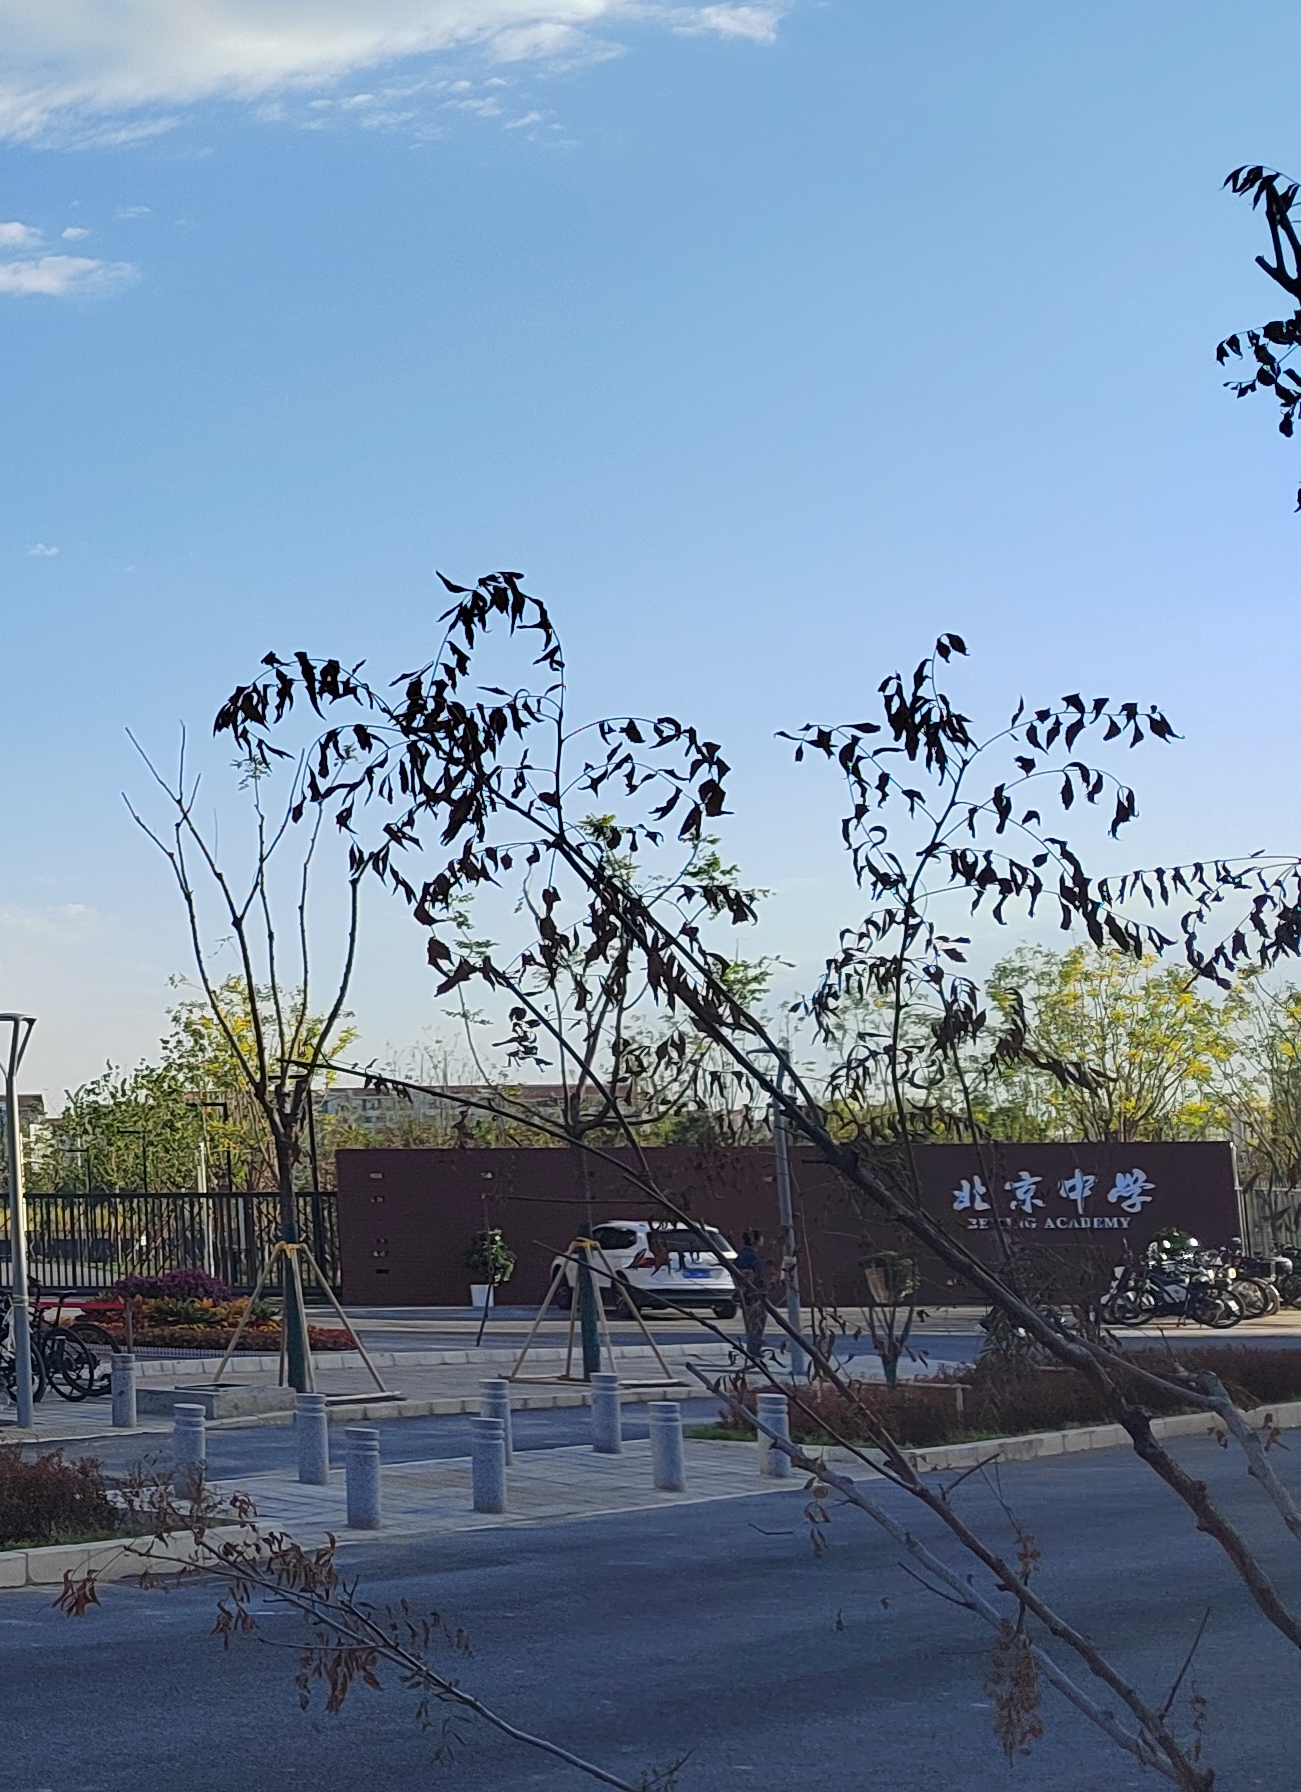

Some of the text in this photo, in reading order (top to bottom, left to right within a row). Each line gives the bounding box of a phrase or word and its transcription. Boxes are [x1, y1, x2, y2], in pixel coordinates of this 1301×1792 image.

[952, 1168, 1156, 1214] 北京中学
[1044, 1217, 1131, 1229] ACADEMY
